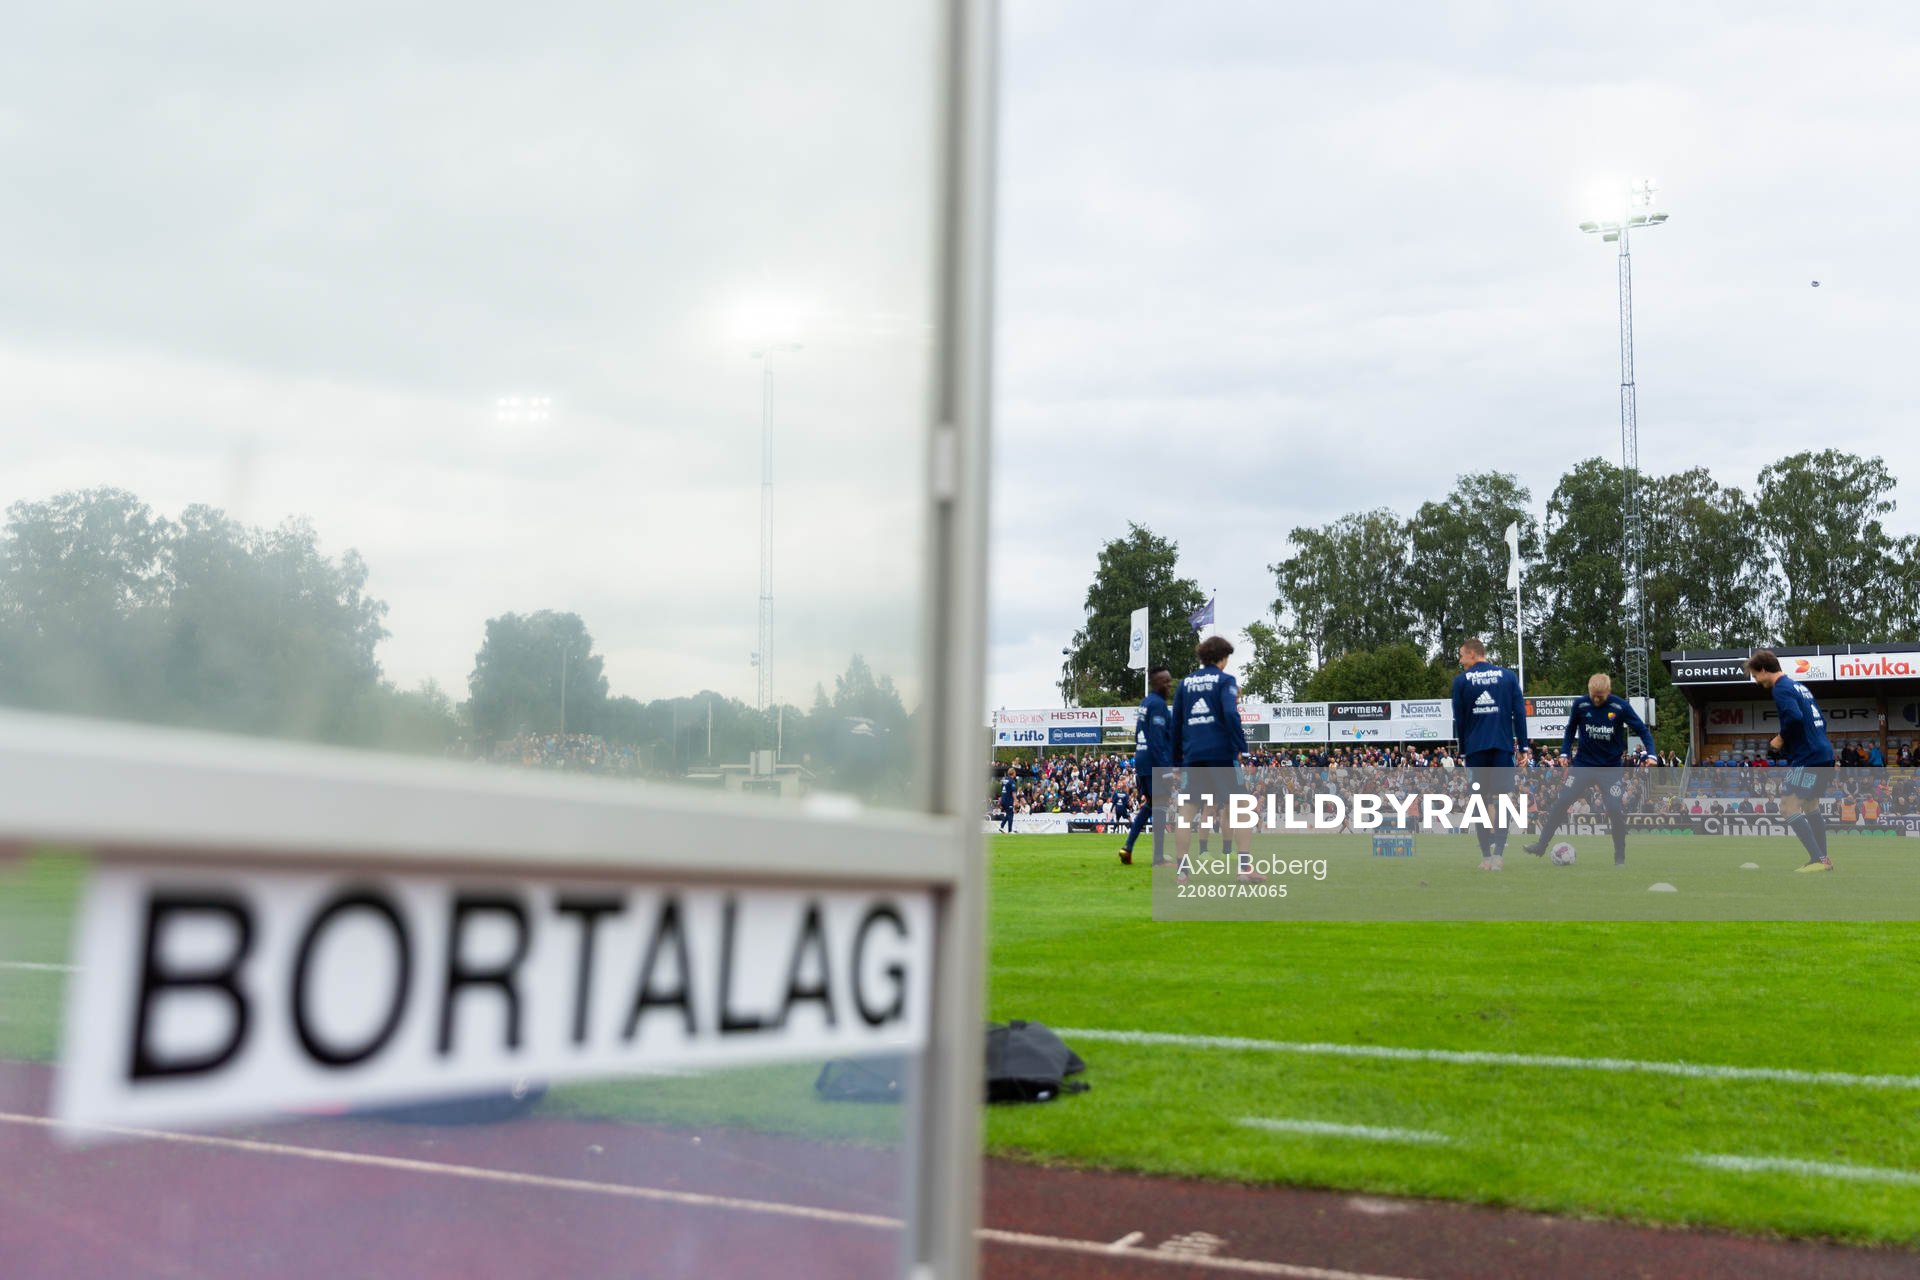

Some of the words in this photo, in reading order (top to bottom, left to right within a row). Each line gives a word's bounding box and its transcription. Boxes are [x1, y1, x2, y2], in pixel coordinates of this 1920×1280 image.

[1677, 667, 1744, 677] FORMENTA
[1806, 671, 1828, 679] Smith
[1337, 706, 1383, 714] OPTIMERA
[1401, 702, 1442, 713] NORIMA
[1051, 711, 1098, 720] HESTRA
[1709, 708, 1743, 724] 3M
[1585, 724, 1614, 733] Prioritet
[126, 884, 912, 1084] BORTALAG
